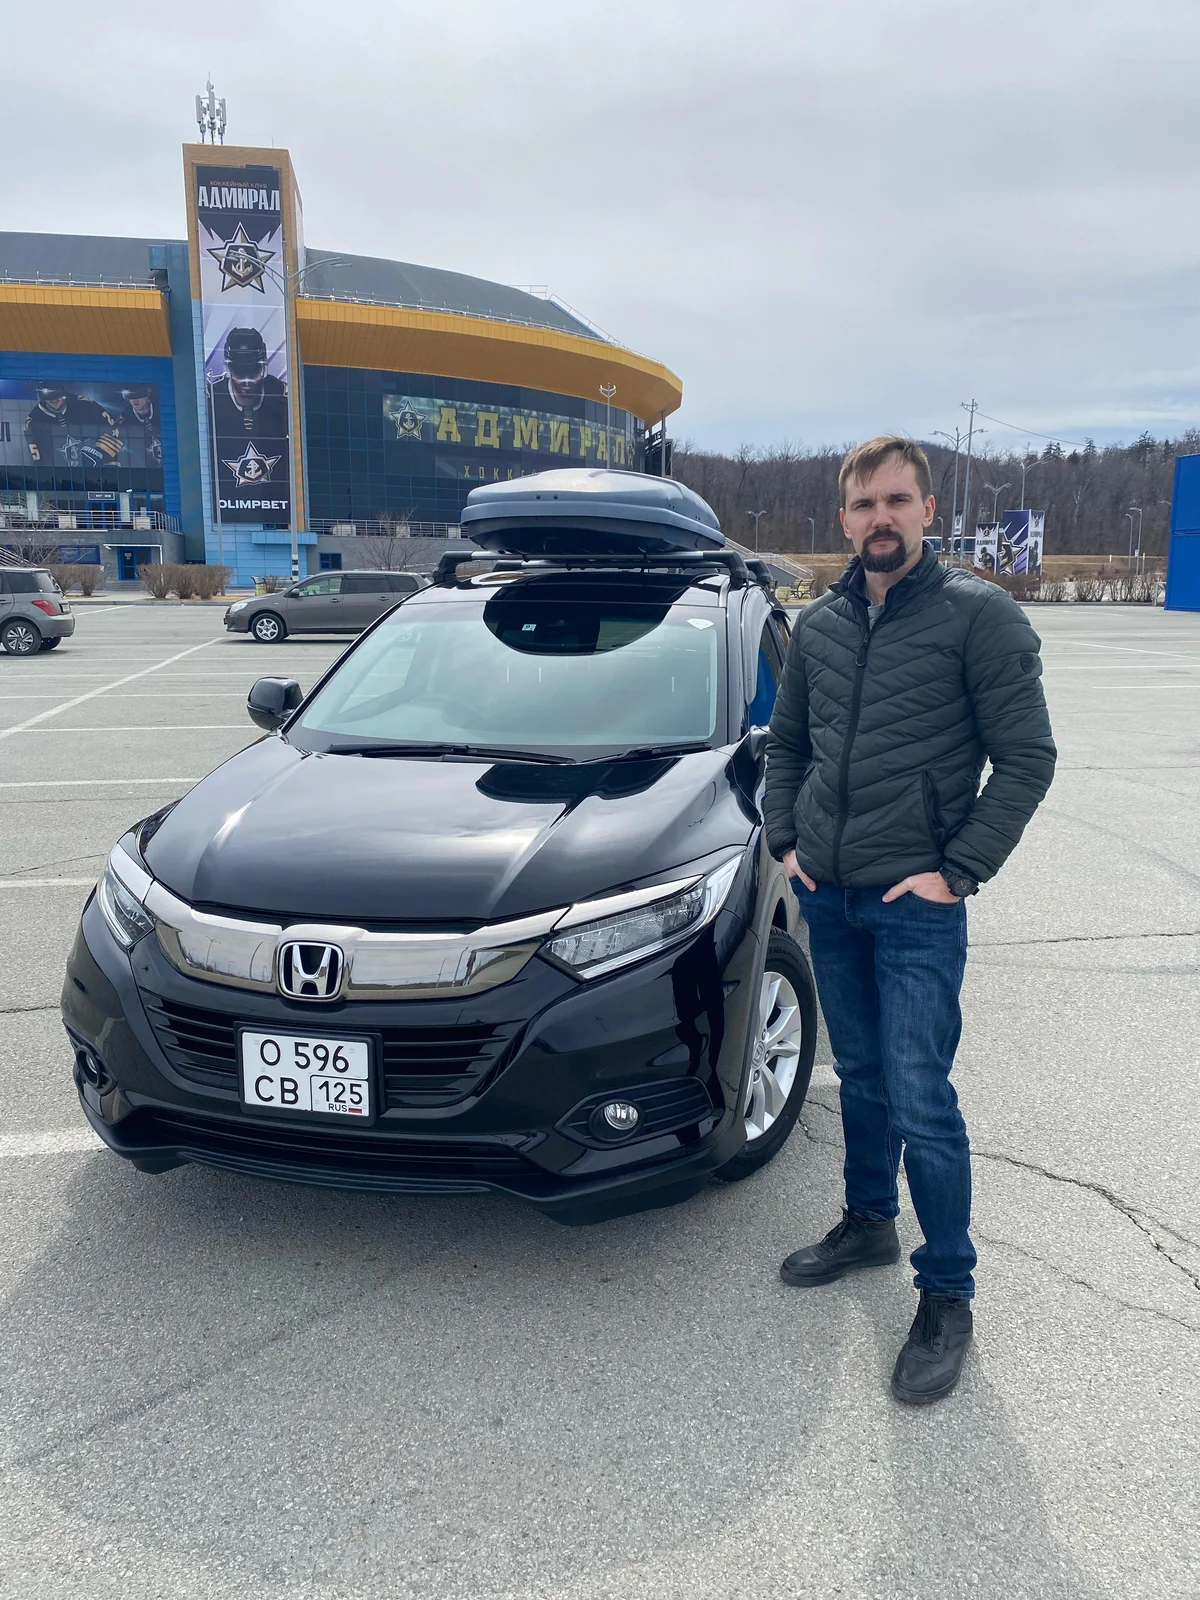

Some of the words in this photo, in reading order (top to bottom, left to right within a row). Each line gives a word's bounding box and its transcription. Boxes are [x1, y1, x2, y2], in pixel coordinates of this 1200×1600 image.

[198, 186, 280, 210] АДМИРАЛ
[436, 406, 625, 465] АДМИРАЛ
[219, 500, 288, 509] OLIMPBET
[294, 1041, 349, 1073] 596
[318, 1080, 363, 1105] 125
[328, 1103, 348, 1112] RUS
